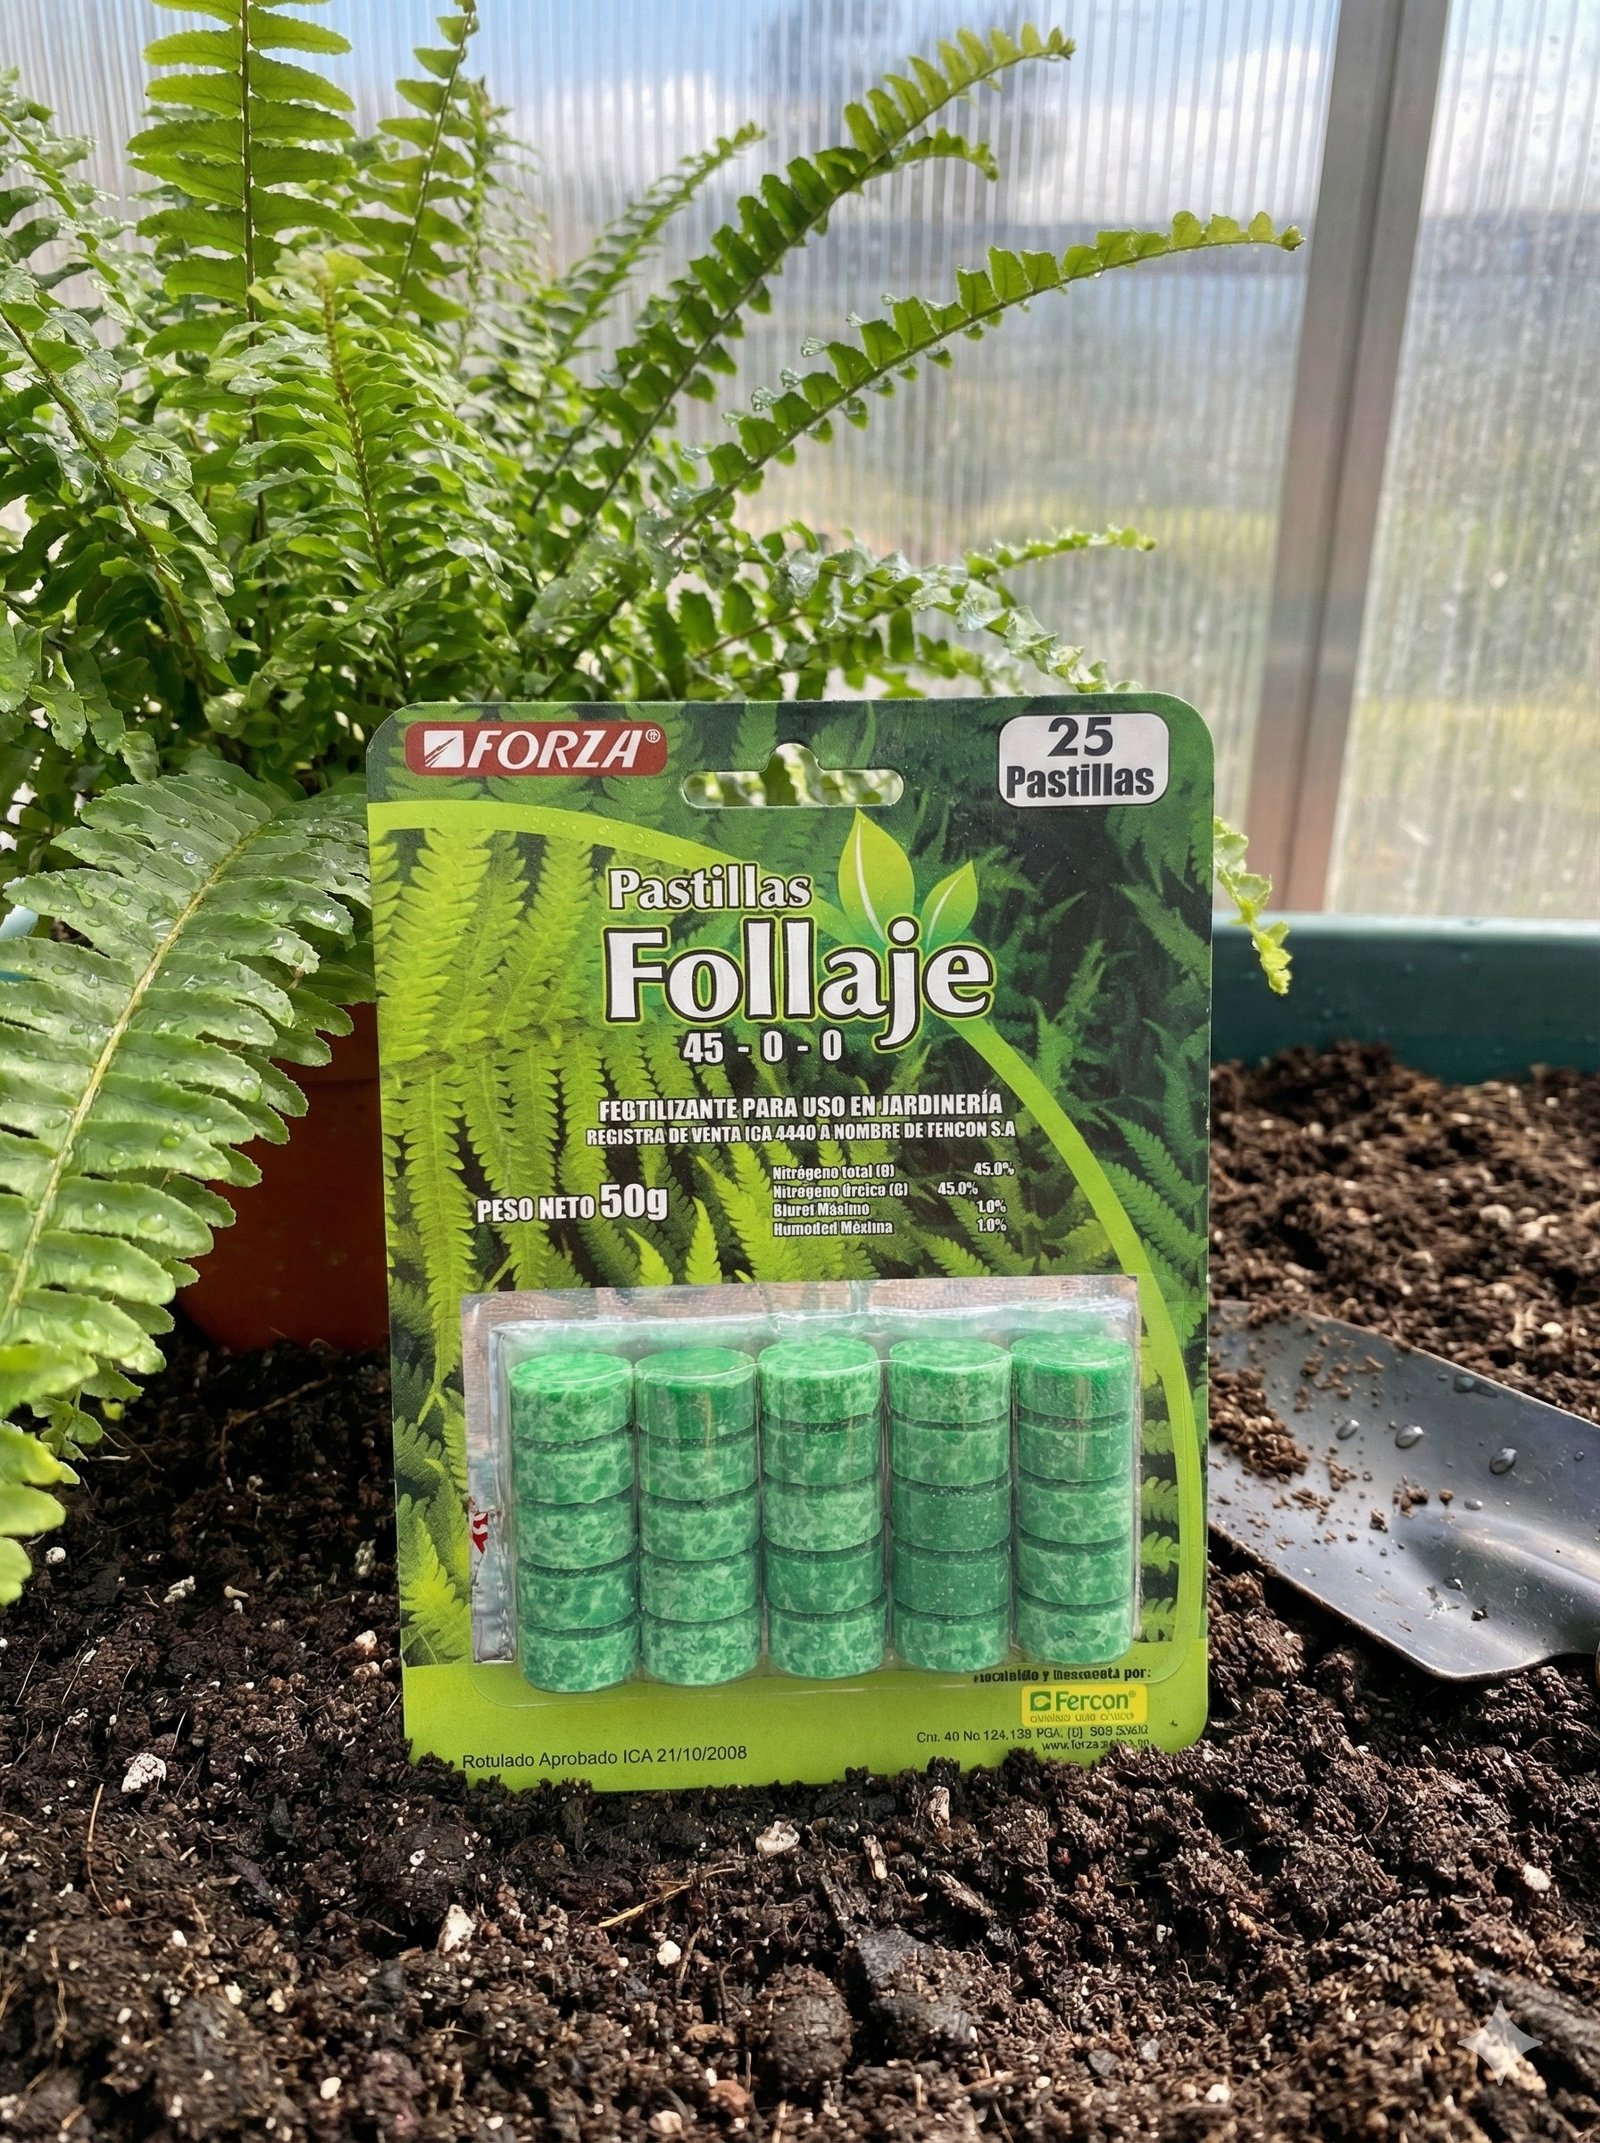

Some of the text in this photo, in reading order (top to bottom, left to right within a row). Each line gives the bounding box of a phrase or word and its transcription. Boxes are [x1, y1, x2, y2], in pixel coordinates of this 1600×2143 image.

[1047, 717, 1113, 757] 25
[1006, 763, 1155, 799] Pastillas
[609, 863, 812, 910] Pastillas
[605, 915, 994, 1049] Follaje
[684, 1032, 723, 1063] 45
[763, 1031, 783, 1062] 0
[822, 1029, 843, 1060] 0
[743, 1097, 798, 1119] PARA
[803, 1096, 846, 1118] USO
[850, 1096, 876, 1116] EN
[880, 1088, 1003, 1116] JARDINERÍA
[586, 1126, 666, 1146] REGISTRA
[669, 1127, 689, 1144] DE
[692, 1125, 742, 1143] VENTA
[745, 1125, 773, 1142] ICA
[775, 1124, 817, 1141] 4440
[820, 1124, 831, 1140] A
[834, 1122, 900, 1140] NOMBRE
[904, 1122, 924, 1139] DE
[973, 1162, 1015, 1176] 45.0%
[937, 1181, 979, 1195] 45.0%
[477, 1183, 668, 1223] PESO NETO 50g
[976, 1199, 1007, 1214] 1.0%
[976, 1218, 1007, 1232] 1.0%
[944, 1731, 960, 1742] 40
[462, 1745, 748, 1769] Rotulado Aprobado ICA 21/10/2008
